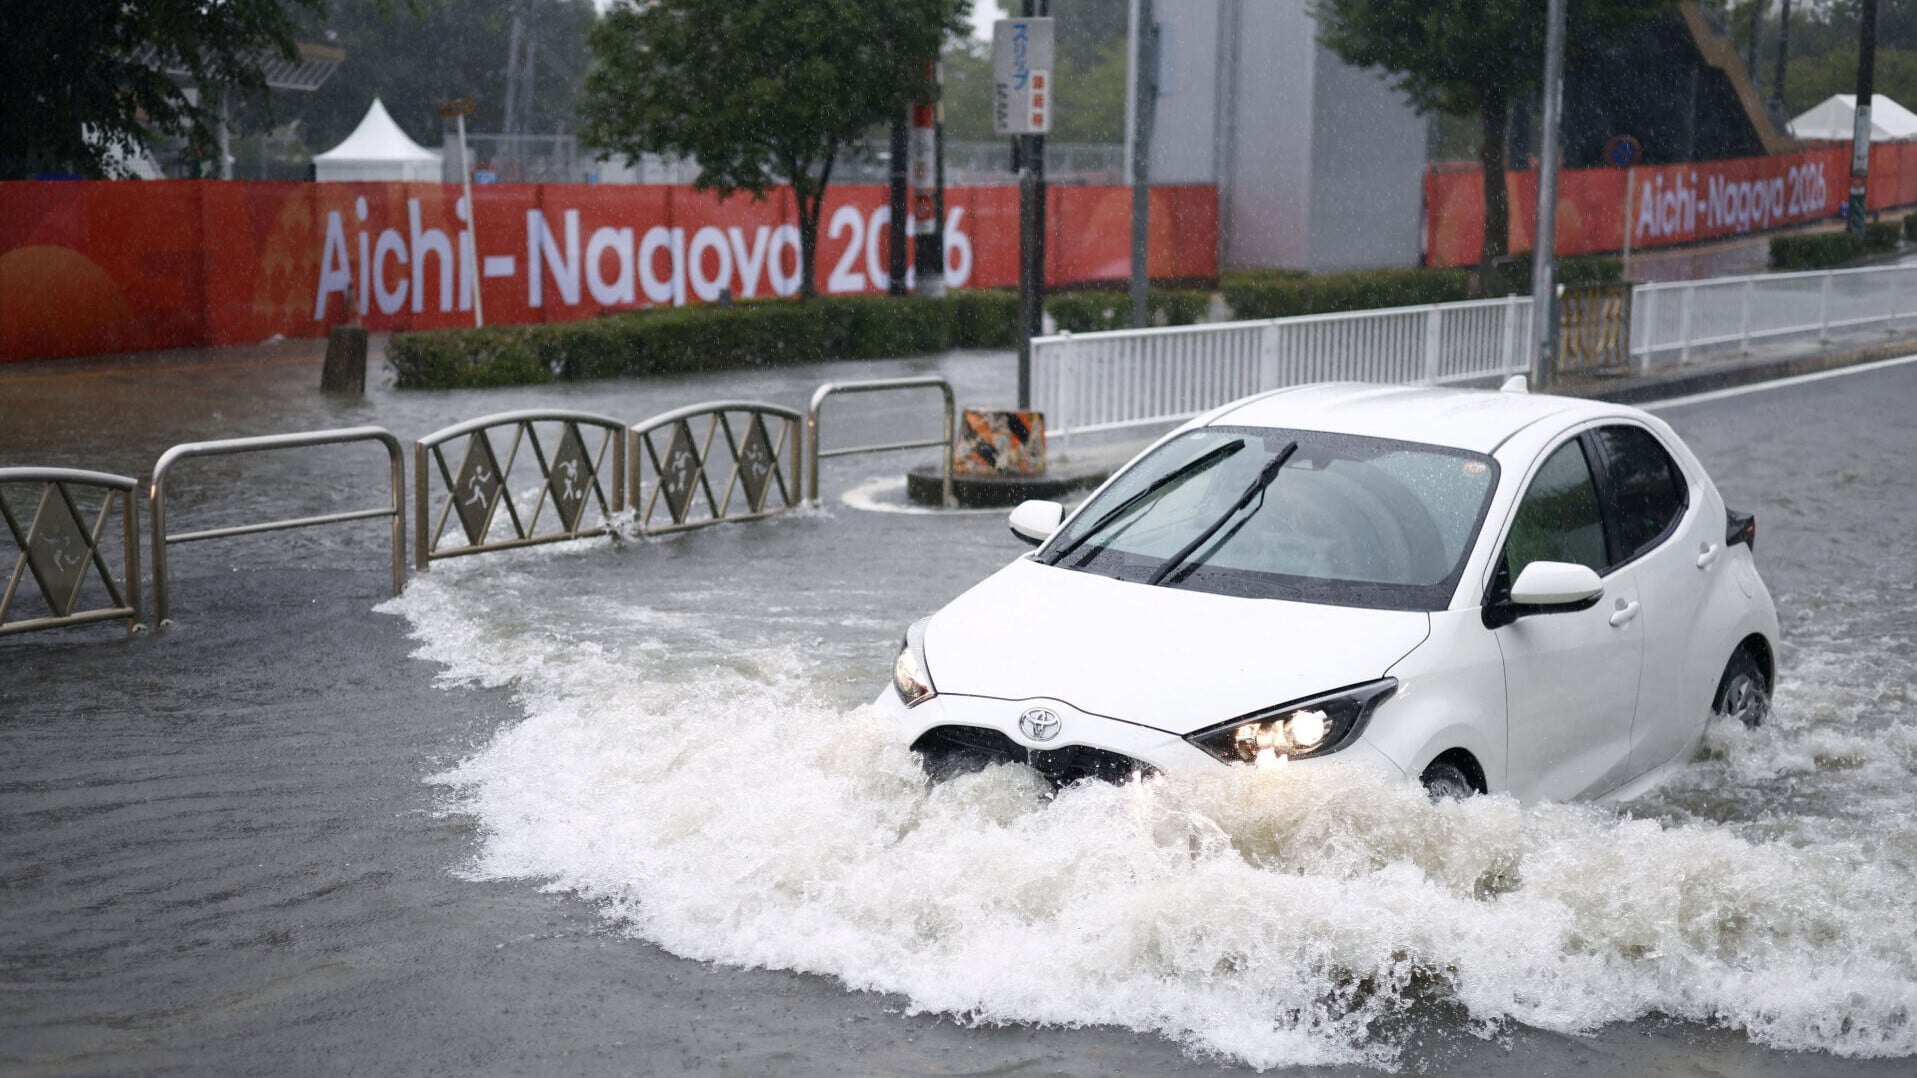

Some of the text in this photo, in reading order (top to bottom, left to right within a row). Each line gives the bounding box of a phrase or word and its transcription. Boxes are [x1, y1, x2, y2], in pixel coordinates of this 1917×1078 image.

[1636, 161, 1827, 239] Aichi-Nagoya 2026
[313, 195, 973, 321] Aichi-Nagoya 206
